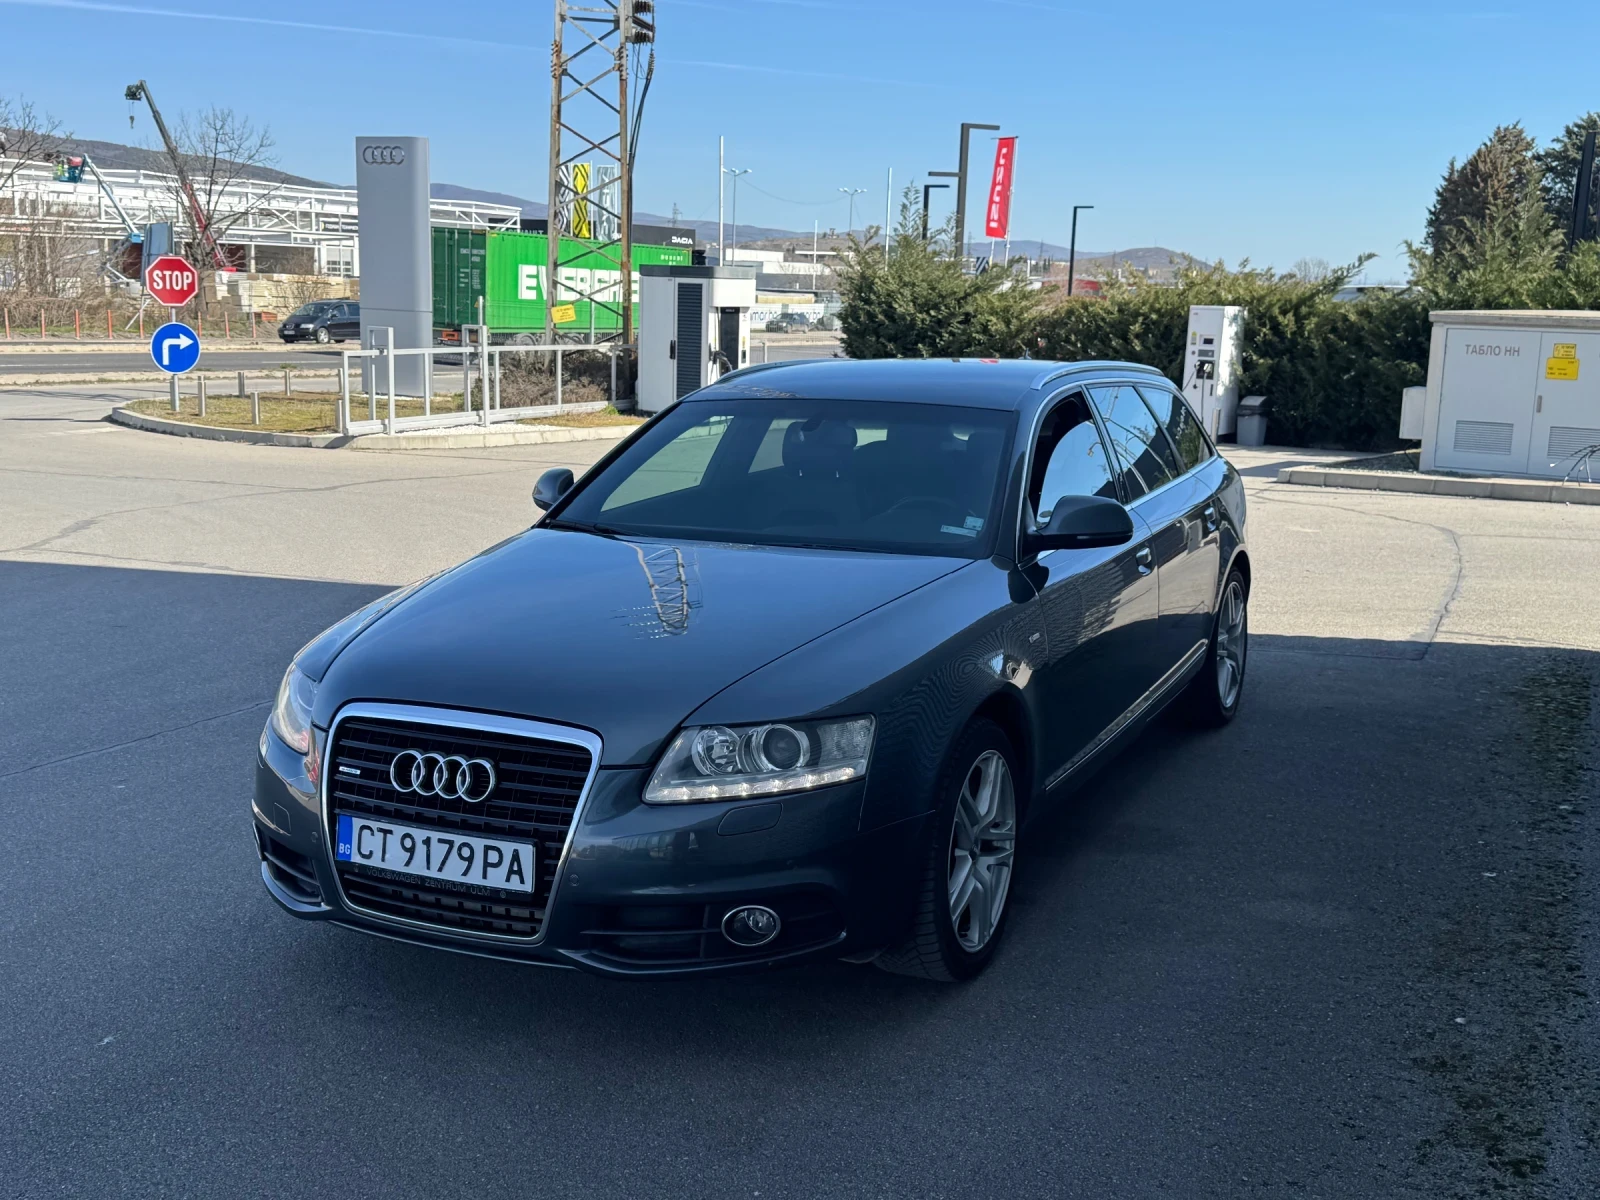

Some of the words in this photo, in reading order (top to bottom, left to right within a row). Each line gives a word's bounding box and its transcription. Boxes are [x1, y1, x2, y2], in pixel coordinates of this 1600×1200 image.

[671, 236, 693, 245] DACIA
[152, 269, 193, 291] STOP
[1465, 344, 1502, 356] ТАБЛО
[1504, 346, 1521, 357] НН
[339, 843, 351, 855] BG
[399, 832, 475, 877] 9179
[367, 868, 421, 885] VOLKSWAGEN
[425, 879, 466, 893] ZENTRUM
[471, 888, 491, 897] ULM
